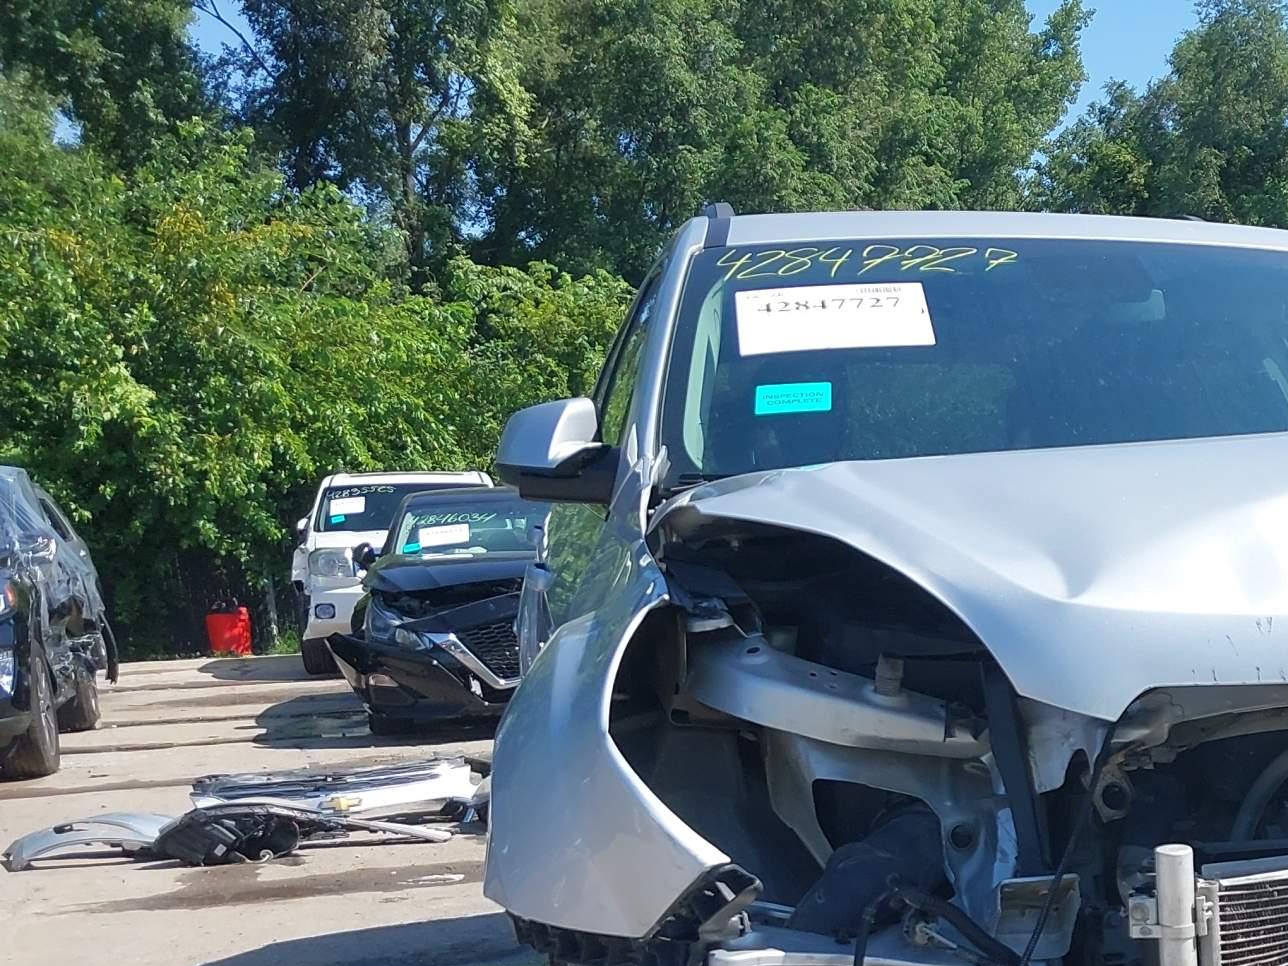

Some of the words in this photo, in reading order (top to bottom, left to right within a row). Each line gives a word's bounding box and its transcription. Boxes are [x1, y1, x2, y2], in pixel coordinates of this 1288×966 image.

[757, 296, 901, 314] 42847727
[762, 391, 824, 400] INSPECTION
[766, 397, 823, 406] COMPLETE
